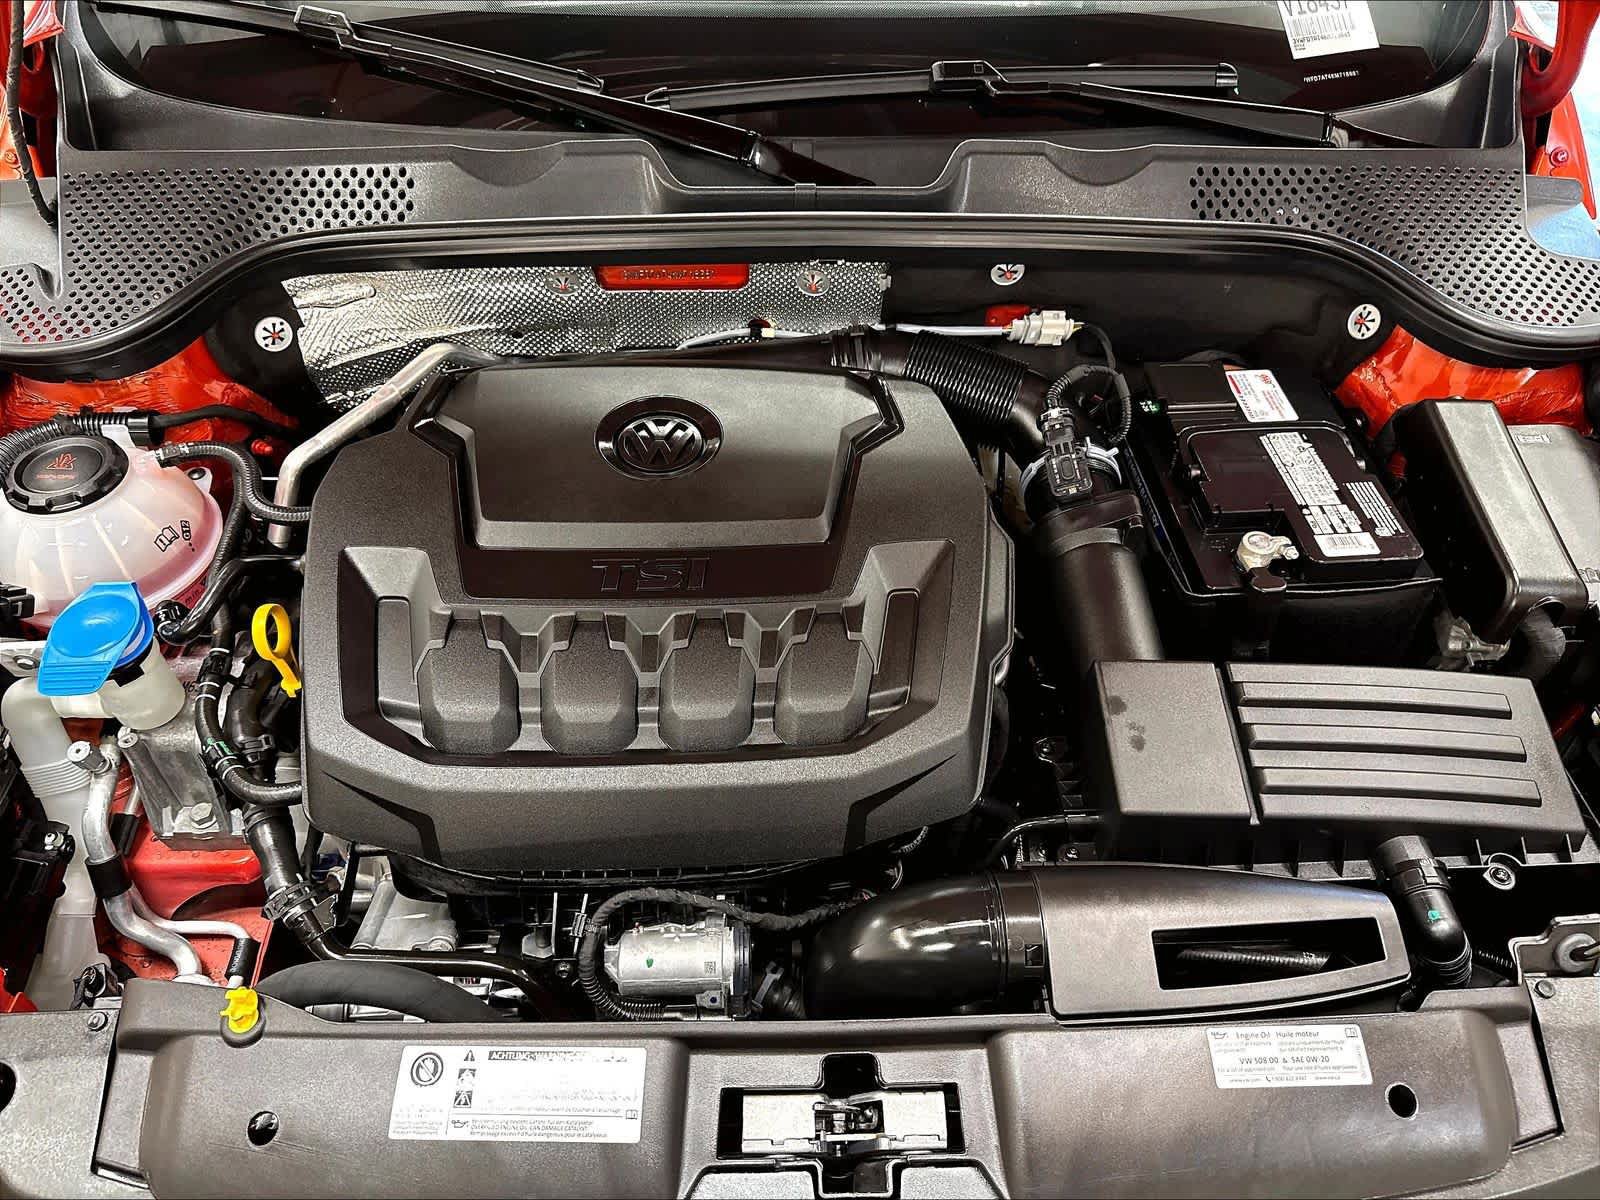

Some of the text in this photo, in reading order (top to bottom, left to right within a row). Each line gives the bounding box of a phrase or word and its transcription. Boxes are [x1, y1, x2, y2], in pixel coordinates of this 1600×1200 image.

[592, 556, 712, 593] TSI
[1236, 1030, 1320, 1041] Engine Oil Huile moteur
[1239, 1056, 1253, 1065] VW
[1282, 1056, 1288, 1064] &
[1305, 1055, 1330, 1063] 0W-20
